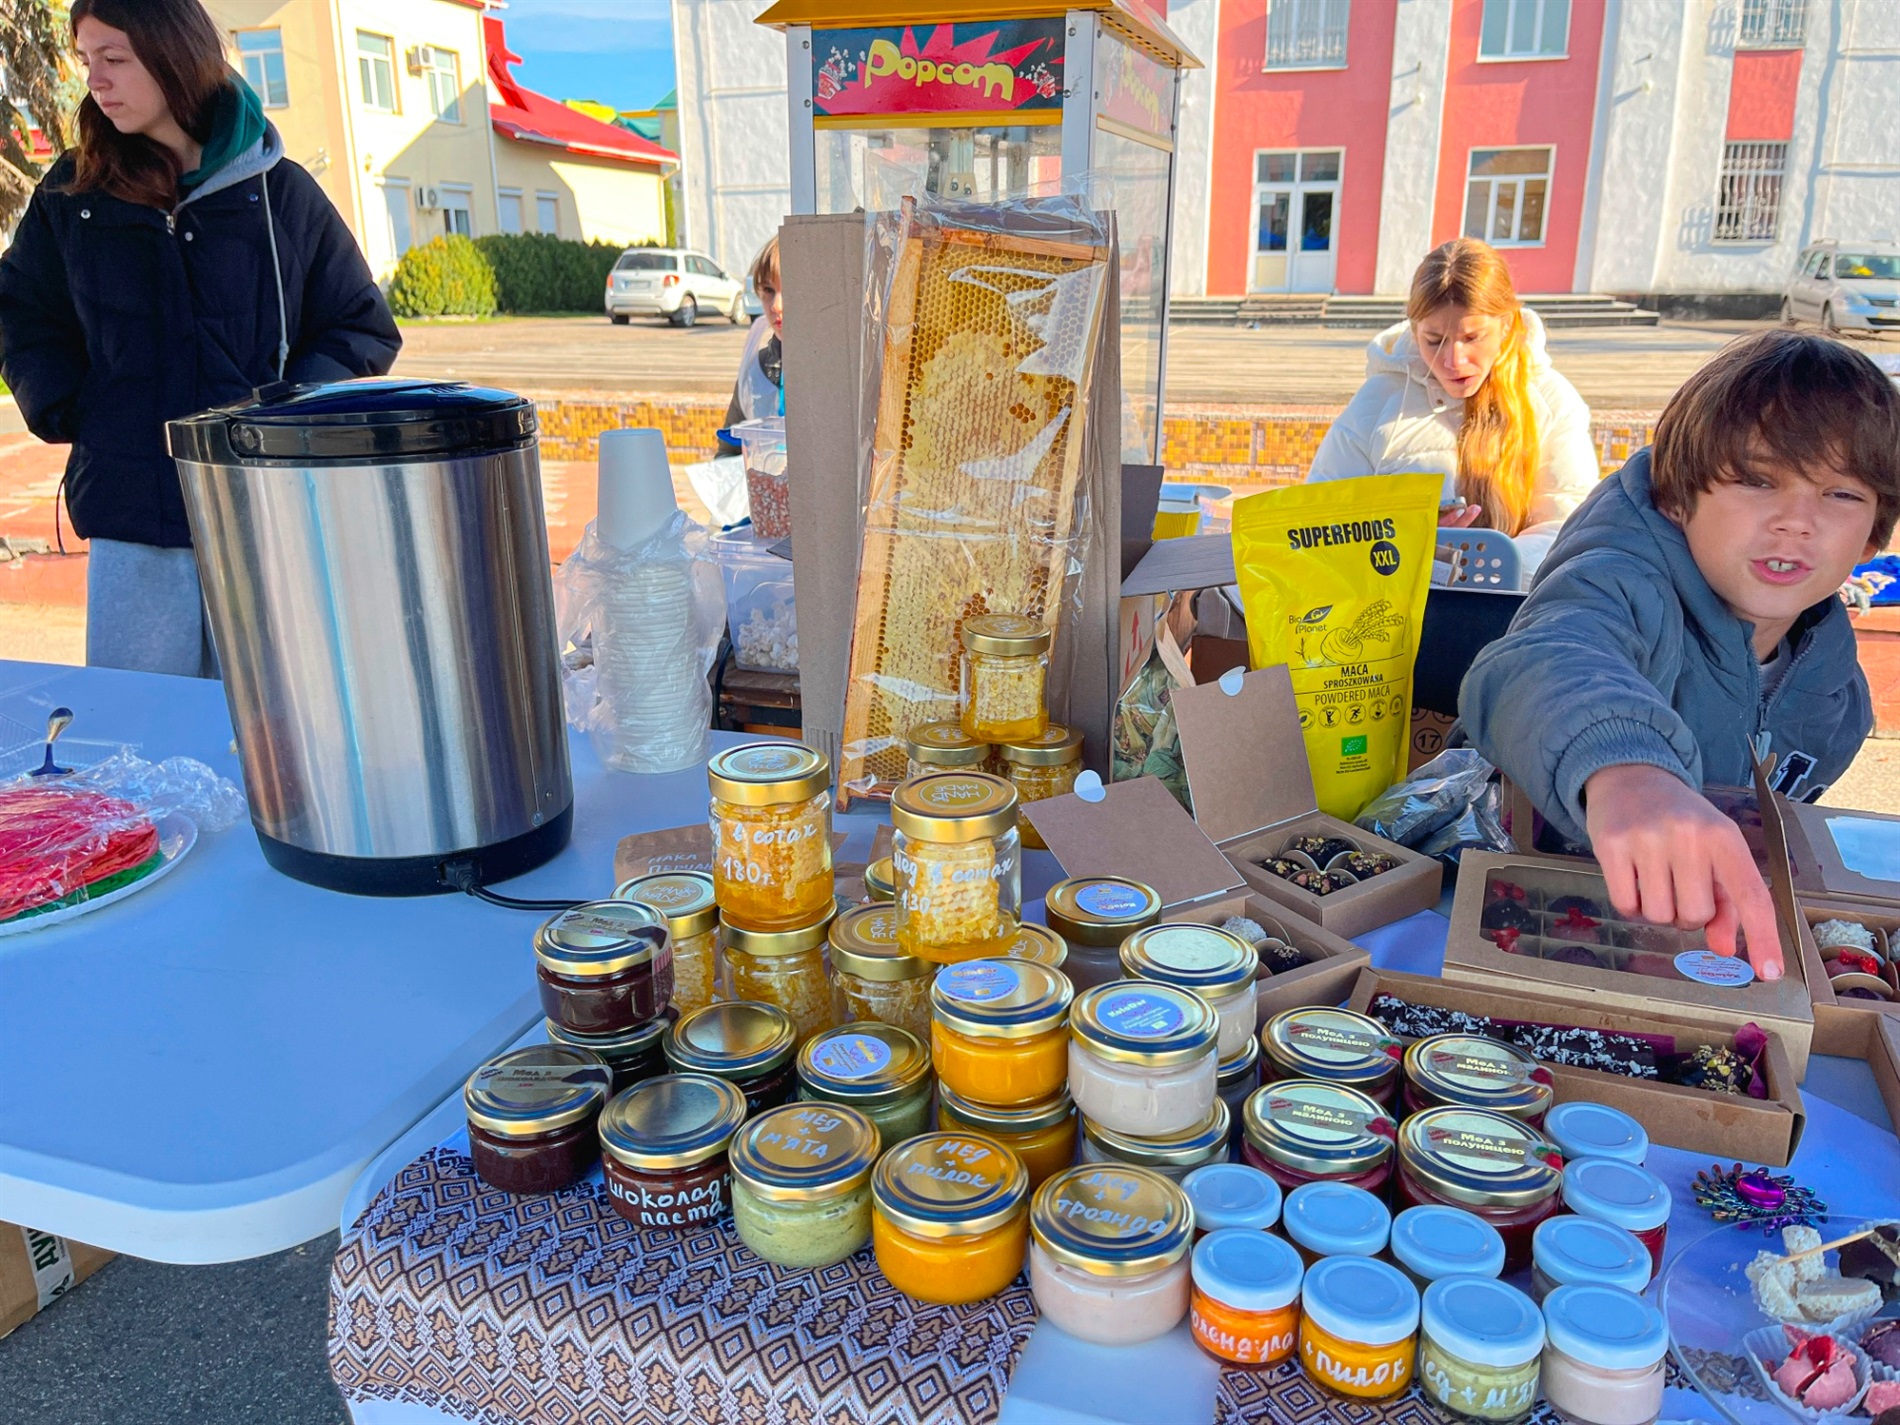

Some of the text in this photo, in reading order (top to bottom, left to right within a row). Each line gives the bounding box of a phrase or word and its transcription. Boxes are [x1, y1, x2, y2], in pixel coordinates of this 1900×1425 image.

[1287, 518, 1396, 550] SUPERFOODS
[1373, 549, 1397, 568] XXL
[1296, 623, 1327, 635] Planet
[1341, 663, 1369, 678] MACA
[1323, 673, 1384, 690] SPROSZKOWANA
[1314, 684, 1391, 706] POWDERED MACA
[1418, 733, 1441, 749] 17
[753, 823, 818, 845] сотах
[1300, 1032, 1371, 1047] полуницею
[1316, 1028, 1344, 1039] Мед
[1465, 1057, 1495, 1068] Мед
[1292, 1110, 1353, 1126] малиною
[1302, 1104, 1333, 1116] Мед
[1443, 1138, 1525, 1156] полуницею
[1460, 1133, 1493, 1145] Мед
